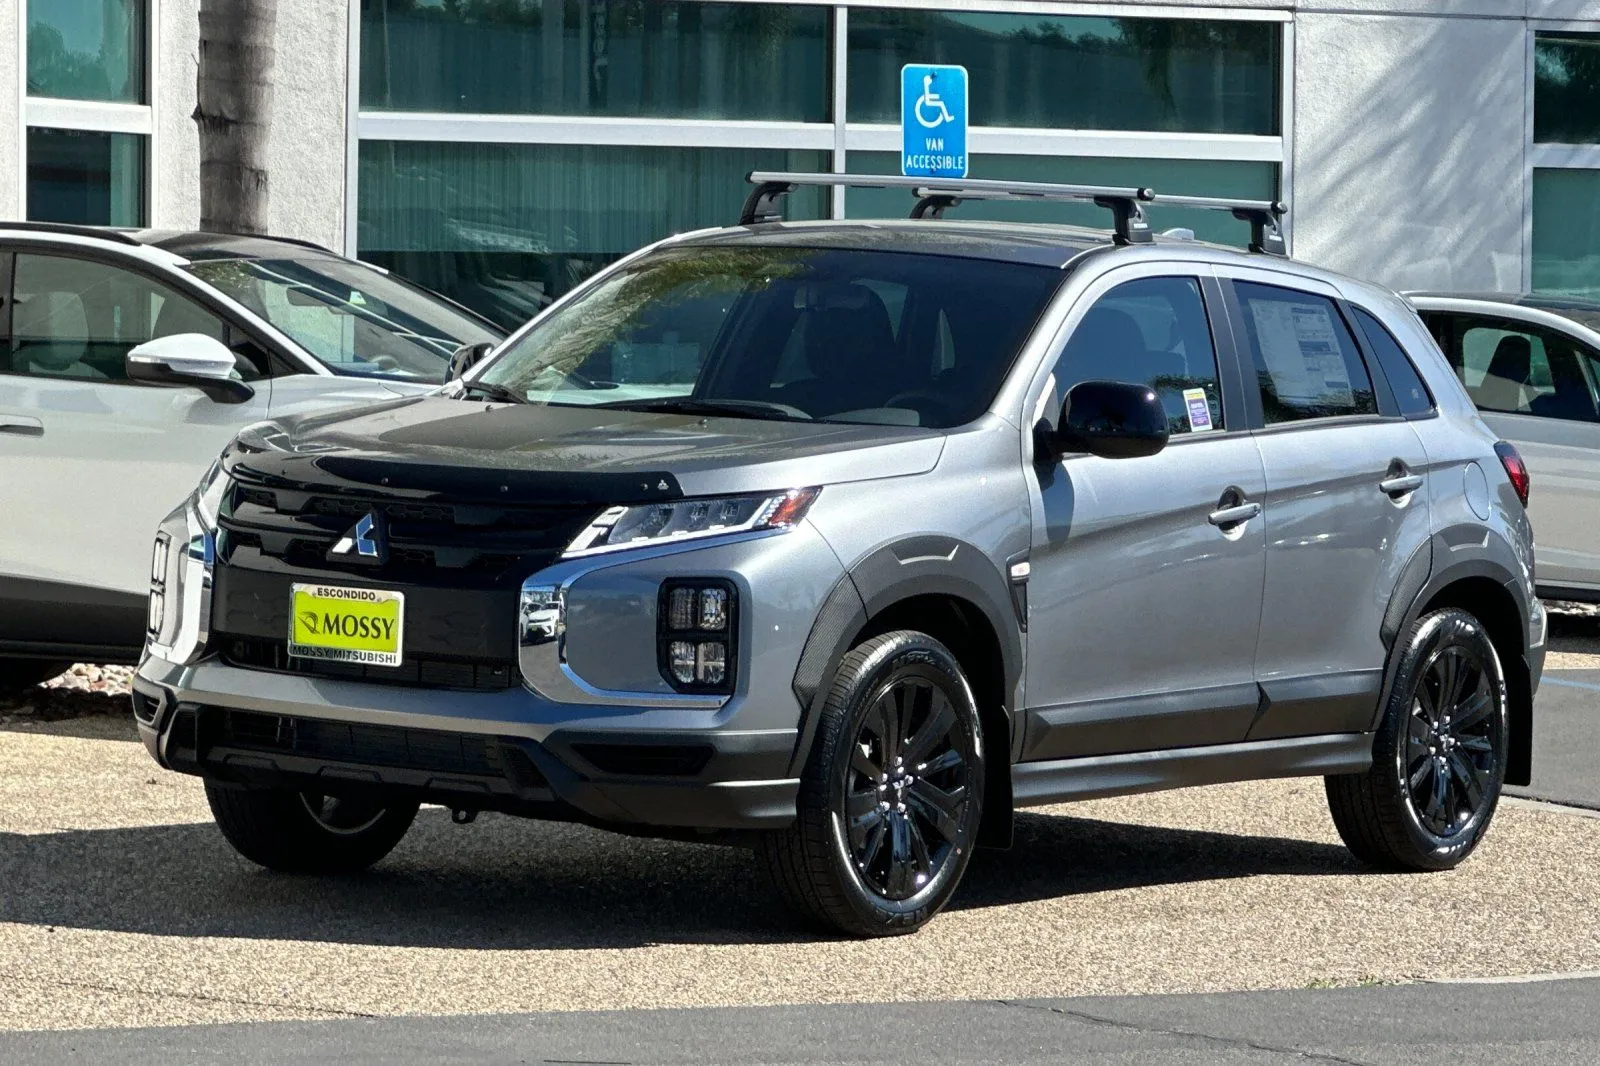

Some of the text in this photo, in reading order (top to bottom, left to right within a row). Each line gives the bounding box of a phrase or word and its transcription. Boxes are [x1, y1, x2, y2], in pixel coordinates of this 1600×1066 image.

[925, 137, 944, 152] VAN
[906, 155, 964, 170] ACCESSIBLE
[317, 587, 376, 601] ESCONDIDO
[323, 612, 395, 640] MOSSY
[291, 645, 397, 664] MOSSY MITSUBISHI
